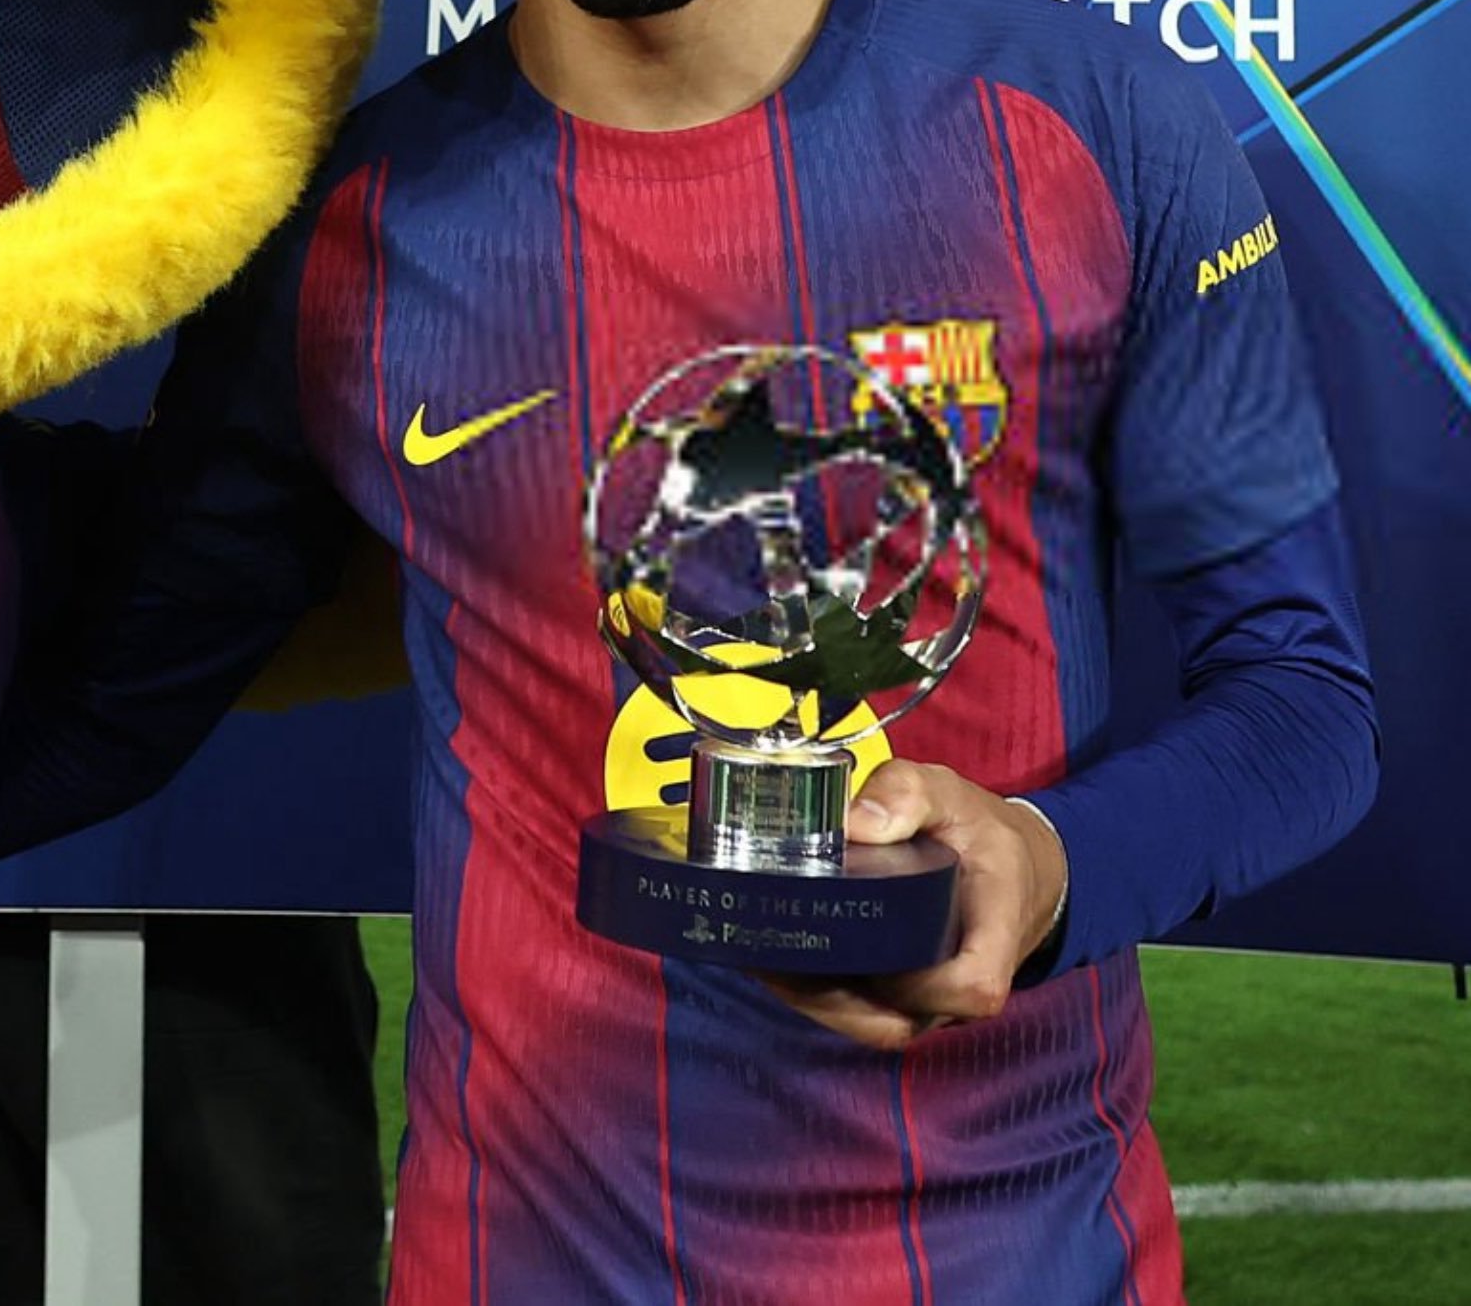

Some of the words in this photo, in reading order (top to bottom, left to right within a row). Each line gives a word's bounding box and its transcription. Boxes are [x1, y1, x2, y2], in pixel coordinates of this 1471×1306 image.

[637, 876, 711, 907] PLAYER
[720, 891, 749, 911] OF
[759, 897, 802, 916] THE
[812, 900, 884, 919] MATCH
[721, 921, 832, 950] PlayStation
